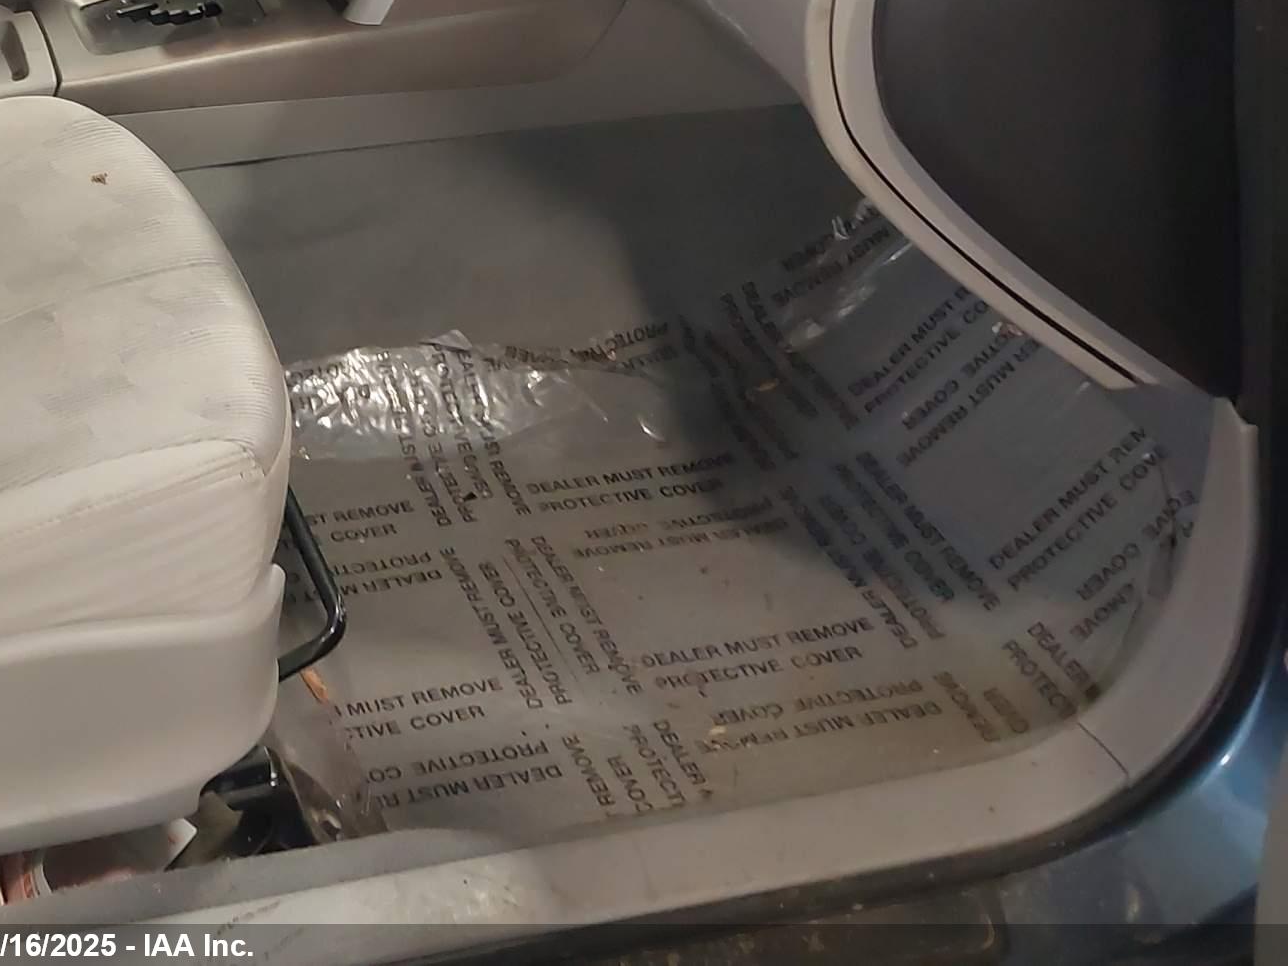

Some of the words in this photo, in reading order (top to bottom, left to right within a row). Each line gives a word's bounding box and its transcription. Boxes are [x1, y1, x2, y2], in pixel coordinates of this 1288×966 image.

[524, 474, 599, 495] DEALER
[602, 468, 655, 486] MUST
[332, 499, 416, 523] REMOVE
[538, 487, 652, 514] PROTECTIVE
[988, 507, 1062, 571] DEALER
[1057, 458, 1110, 510] MUST
[330, 522, 399, 543] COVER
[1007, 490, 1119, 592] PROTECTIVE
[362, 569, 443, 594] DEALER
[641, 643, 723, 669] DEALER
[724, 633, 783, 656] MUST
[785, 616, 876, 644] REMOVE
[791, 645, 865, 670] COVER
[346, 694, 405, 717] MUST
[412, 677, 504, 705] REMOVE
[409, 705, 486, 731] COVER
[793, 714, 856, 739] MUST
[412, 739, 550, 776] PROTECTIVE
[475, 763, 563, 793] DEALER
[408, 780, 469, 805] MUST
